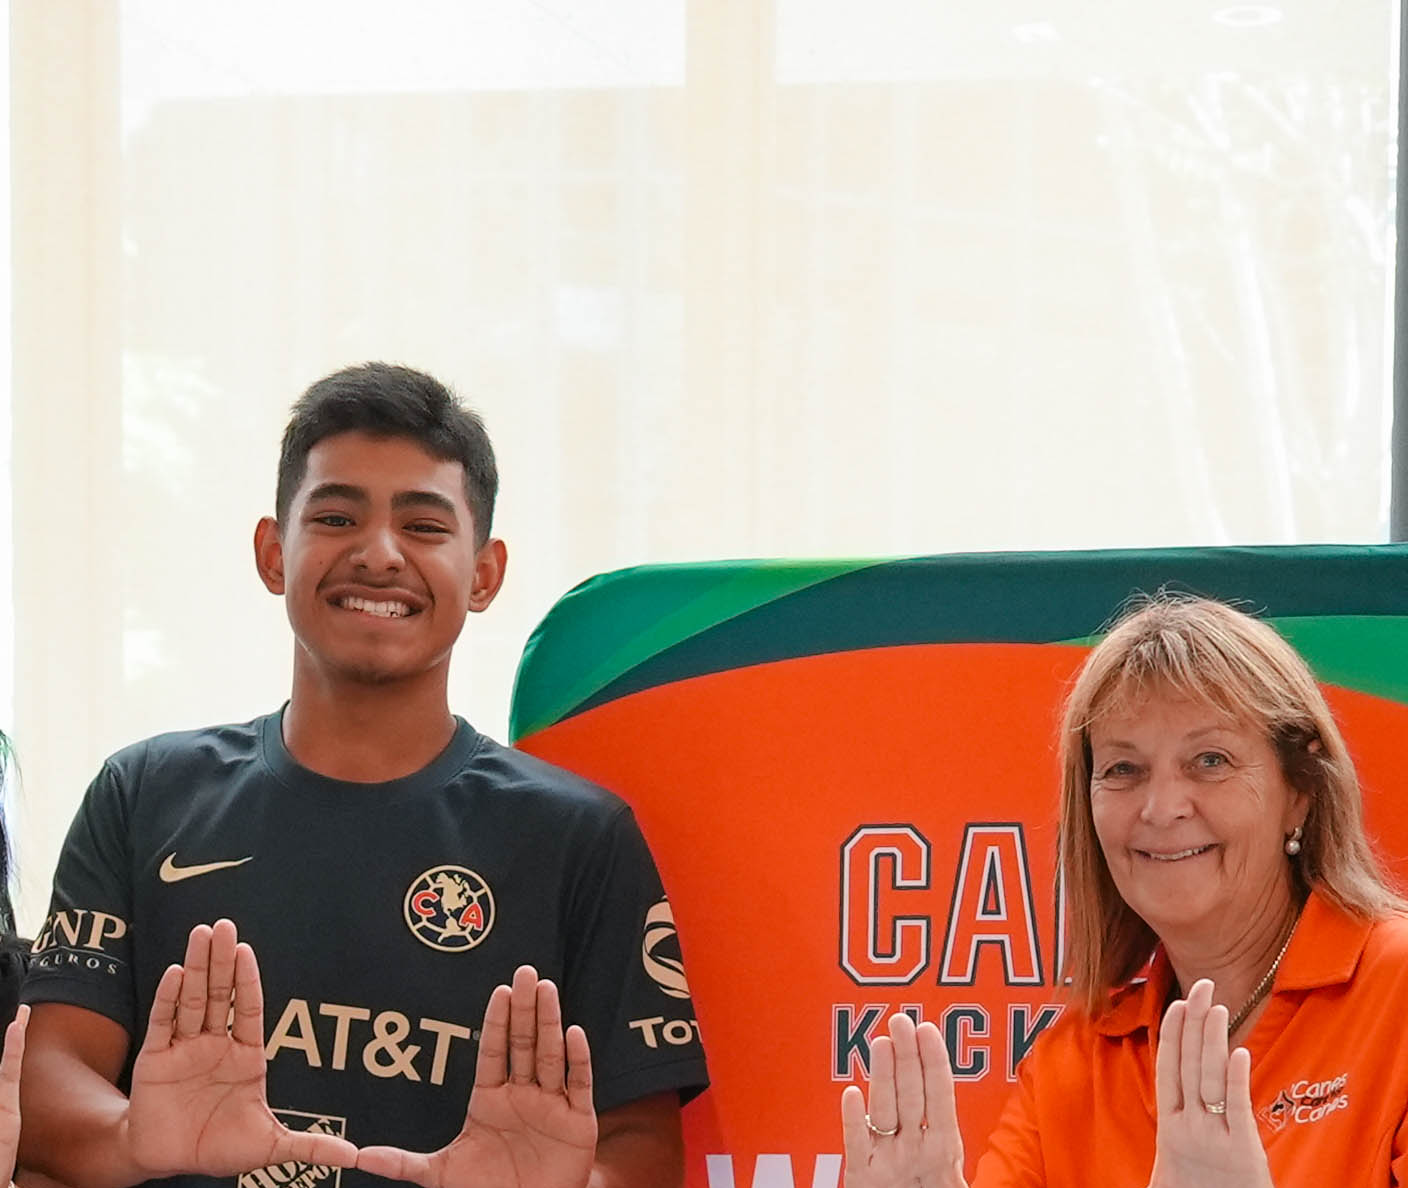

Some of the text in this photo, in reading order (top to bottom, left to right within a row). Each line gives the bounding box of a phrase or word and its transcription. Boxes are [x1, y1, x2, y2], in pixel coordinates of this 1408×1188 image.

[839, 822, 1072, 987] CA
[264, 998, 472, 1086] AT&T
[831, 1003, 1066, 1082] KCK
[1291, 1073, 1349, 1099] Canes
